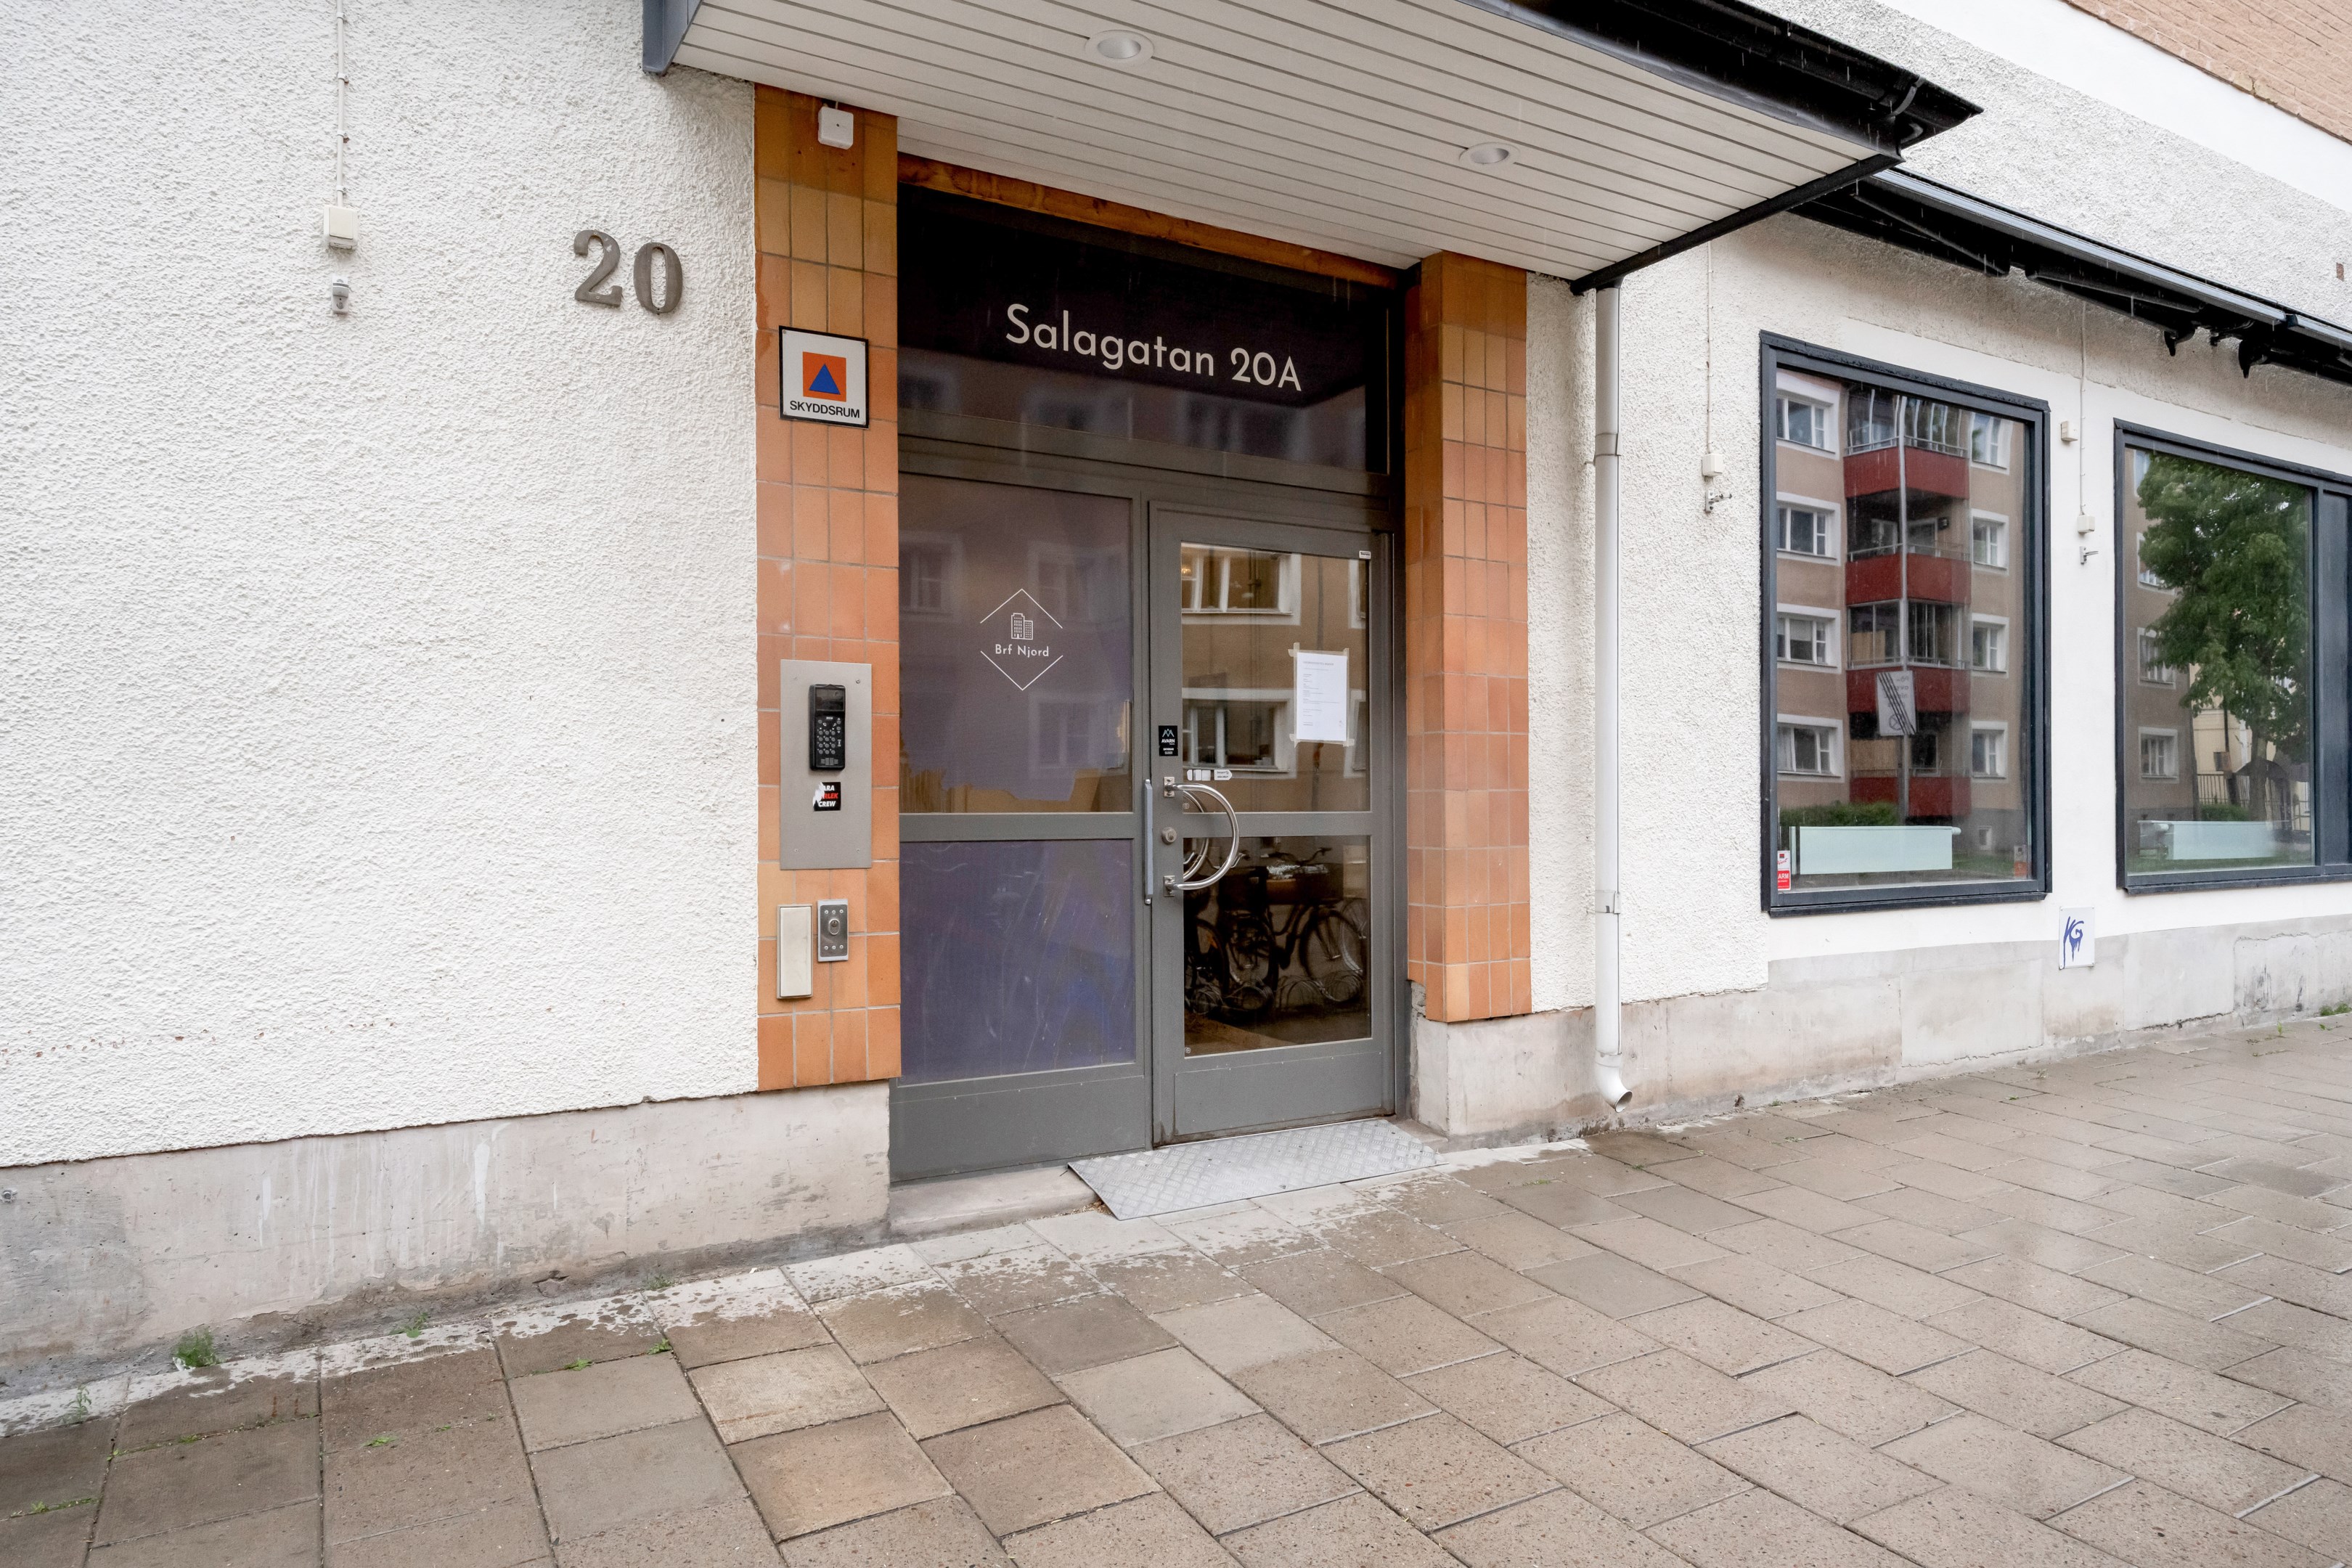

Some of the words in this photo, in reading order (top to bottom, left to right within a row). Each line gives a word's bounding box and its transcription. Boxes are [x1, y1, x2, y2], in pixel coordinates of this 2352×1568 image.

[573, 229, 684, 314] 20
[1005, 303, 1214, 376] Salagatan
[1230, 348, 1302, 391] 20A
[790, 400, 860, 419] SKYDDSRUM
[995, 644, 1013, 654] Brf
[1017, 645, 1049, 658] Njord
